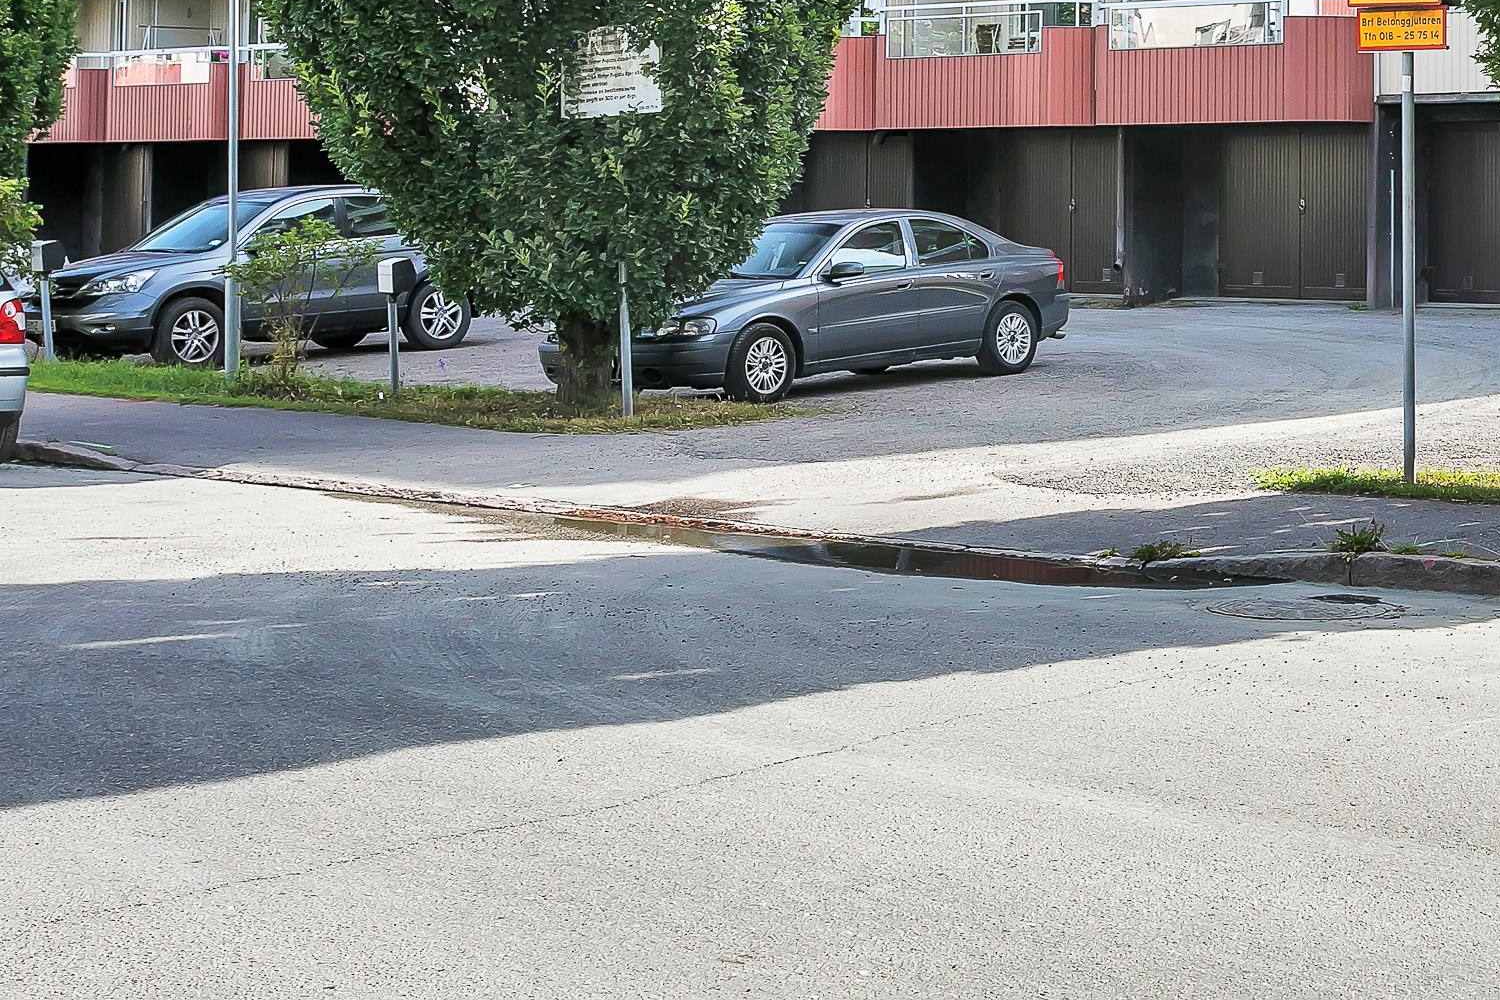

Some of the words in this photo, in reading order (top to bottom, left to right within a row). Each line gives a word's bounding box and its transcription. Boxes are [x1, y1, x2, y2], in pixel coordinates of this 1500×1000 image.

[1362, 17, 1374, 26] Brf
[1377, 17, 1441, 27] Betonggjutaren
[1364, 32, 1377, 41] Tfn
[1379, 31, 1394, 41] 018
[1404, 30, 1415, 40] 25
[1417, 30, 1428, 40] 75
[1430, 30, 1440, 39] 14
